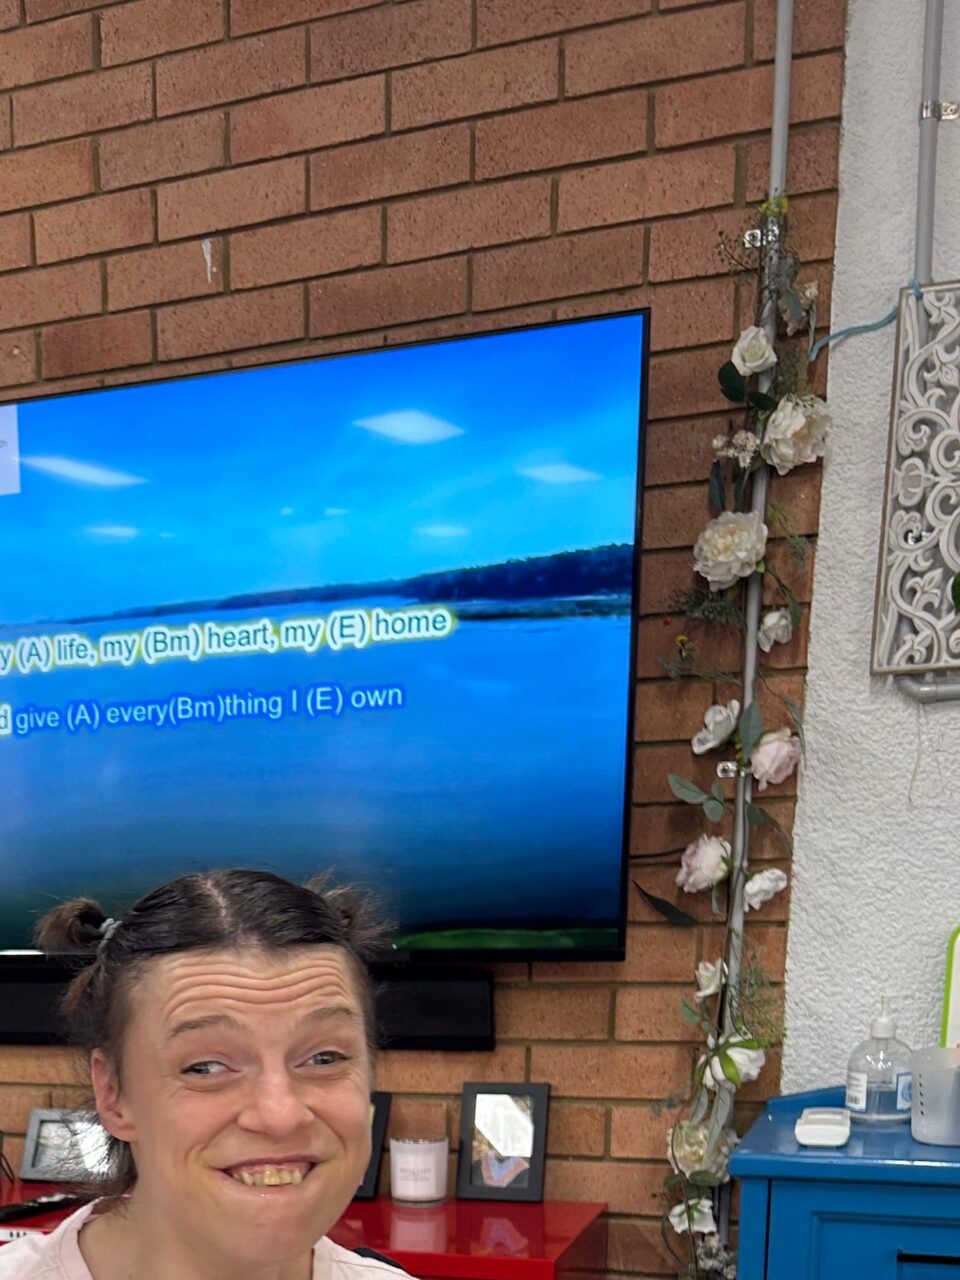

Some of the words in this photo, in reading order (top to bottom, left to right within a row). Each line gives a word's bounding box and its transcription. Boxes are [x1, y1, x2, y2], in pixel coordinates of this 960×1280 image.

[18, 640, 51, 671] (A)
[57, 637, 97, 663] life,
[103, 636, 137, 664] my
[144, 627, 200, 662] (Bm)
[207, 622, 276, 649] heart,
[284, 622, 322, 650] my
[329, 612, 367, 648] (E)
[374, 610, 448, 636] home
[16, 706, 60, 735] give
[67, 703, 100, 731] (A)
[307, 686, 343, 716] (E)
[350, 687, 403, 708] own
